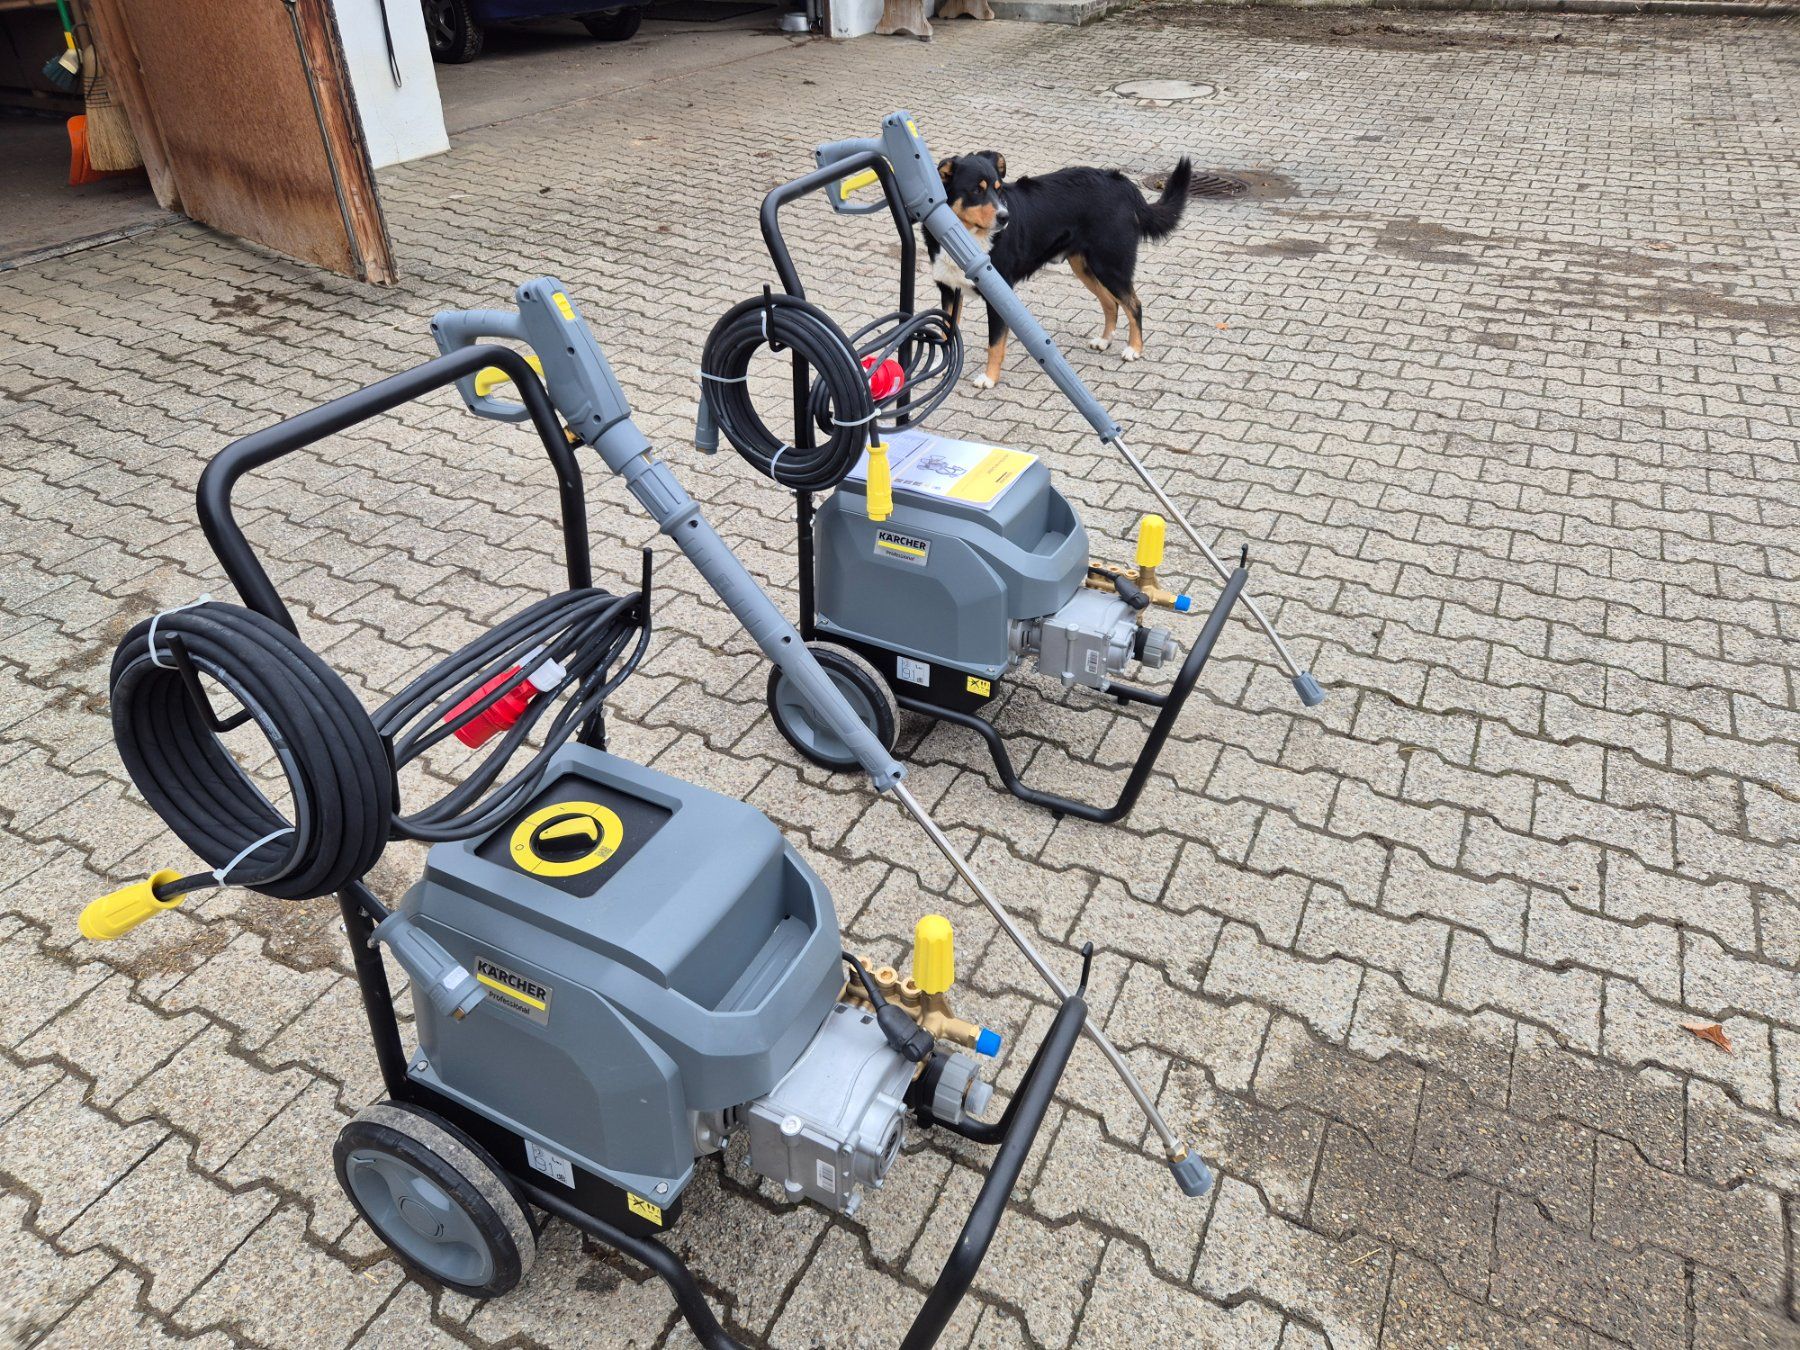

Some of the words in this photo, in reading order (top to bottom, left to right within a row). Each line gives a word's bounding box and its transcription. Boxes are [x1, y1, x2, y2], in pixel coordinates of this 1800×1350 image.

[879, 532, 926, 550] KÄRCHER
[477, 960, 547, 1001] KÄRCHER
[488, 990, 530, 1015] Professional
